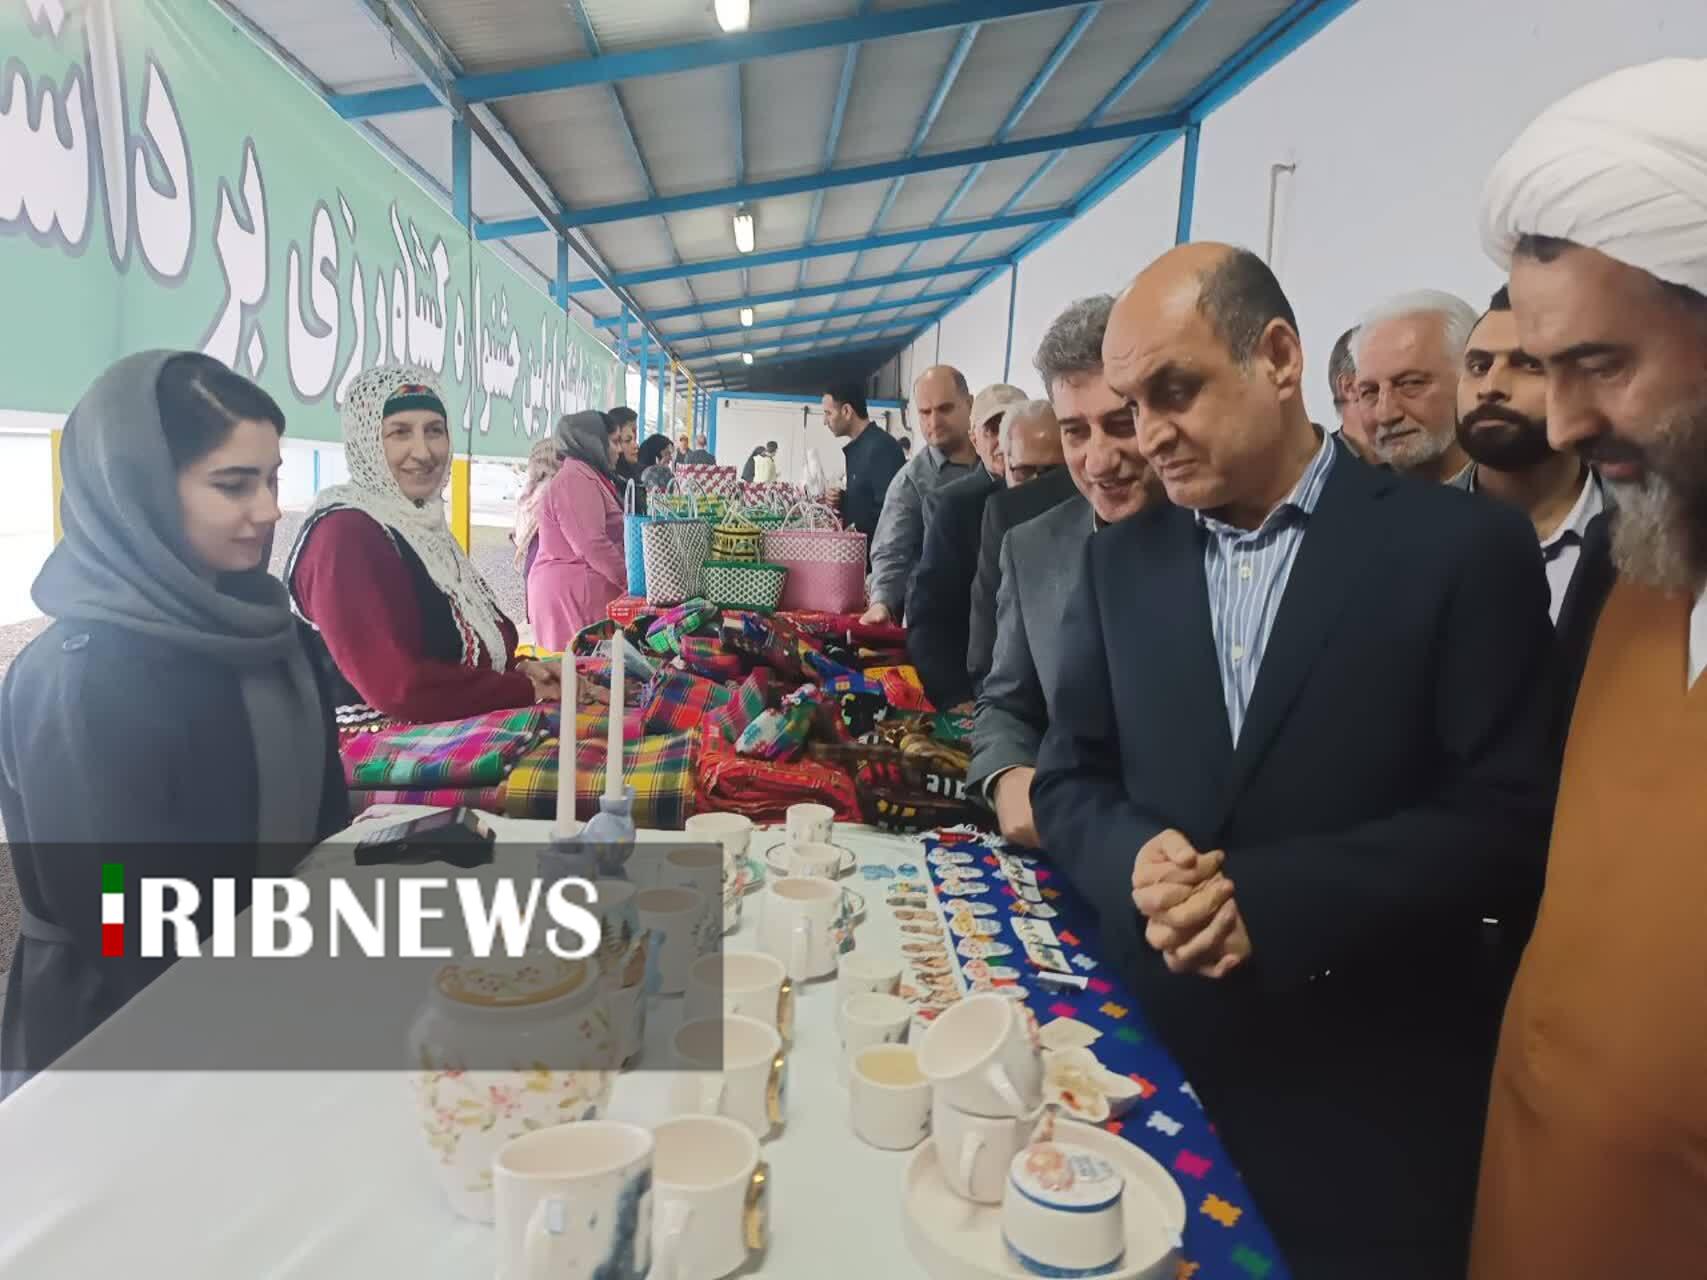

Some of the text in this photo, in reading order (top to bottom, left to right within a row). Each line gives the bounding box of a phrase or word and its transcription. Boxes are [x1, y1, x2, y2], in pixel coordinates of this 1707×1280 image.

[288, 190, 450, 402] کشاورزی
[456, 265, 522, 433] جشنواره
[522, 317, 558, 440] اولین
